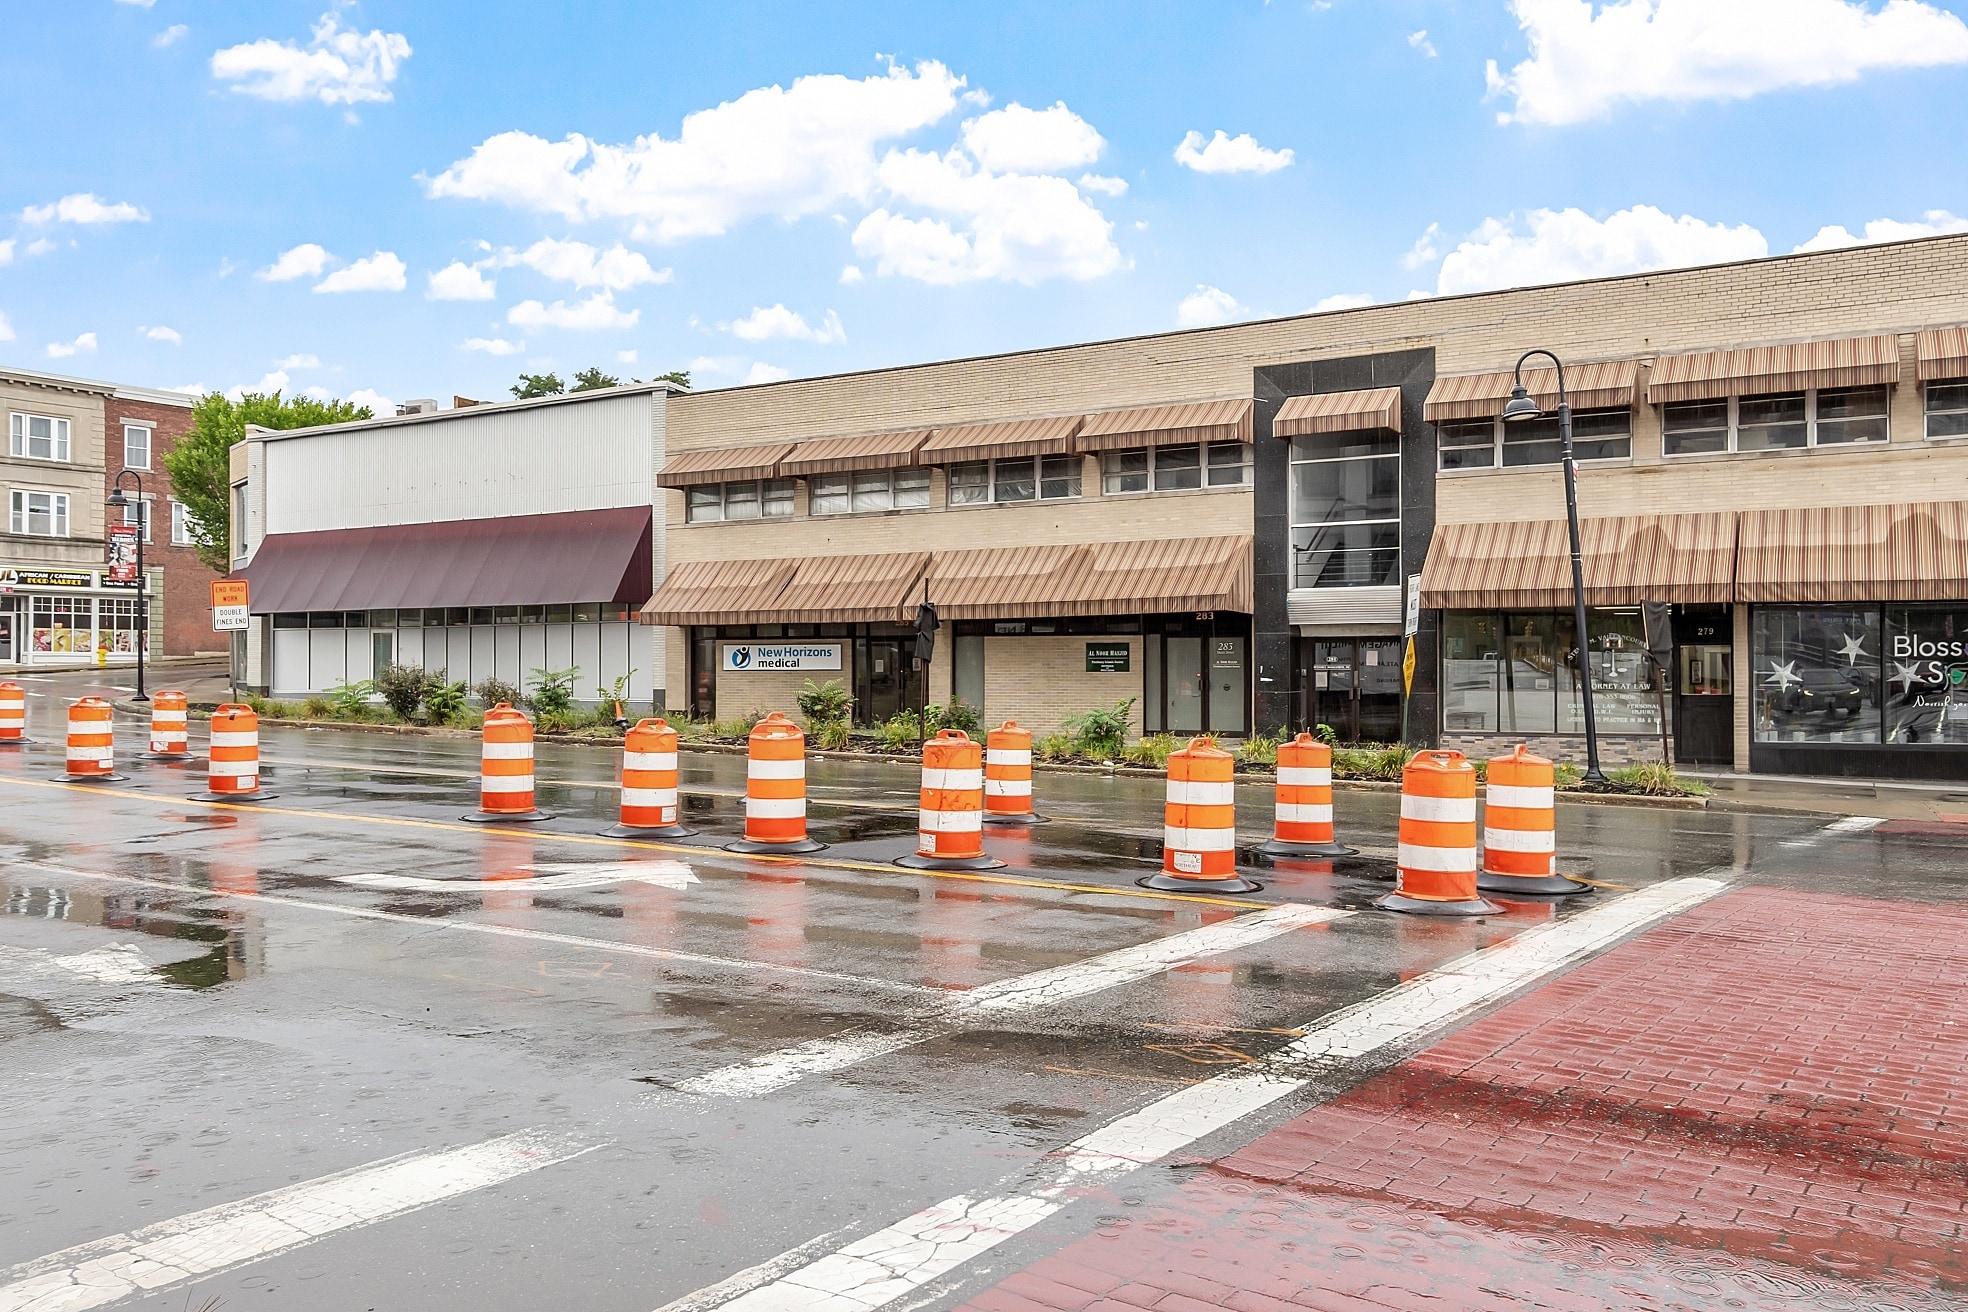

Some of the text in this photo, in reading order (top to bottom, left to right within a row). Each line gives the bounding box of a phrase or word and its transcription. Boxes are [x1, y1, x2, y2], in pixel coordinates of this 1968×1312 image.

[1196, 611, 1214, 620] 283
[1697, 627, 1714, 636] 279
[758, 646, 832, 657] New Horizons
[758, 658, 800, 668] medical
